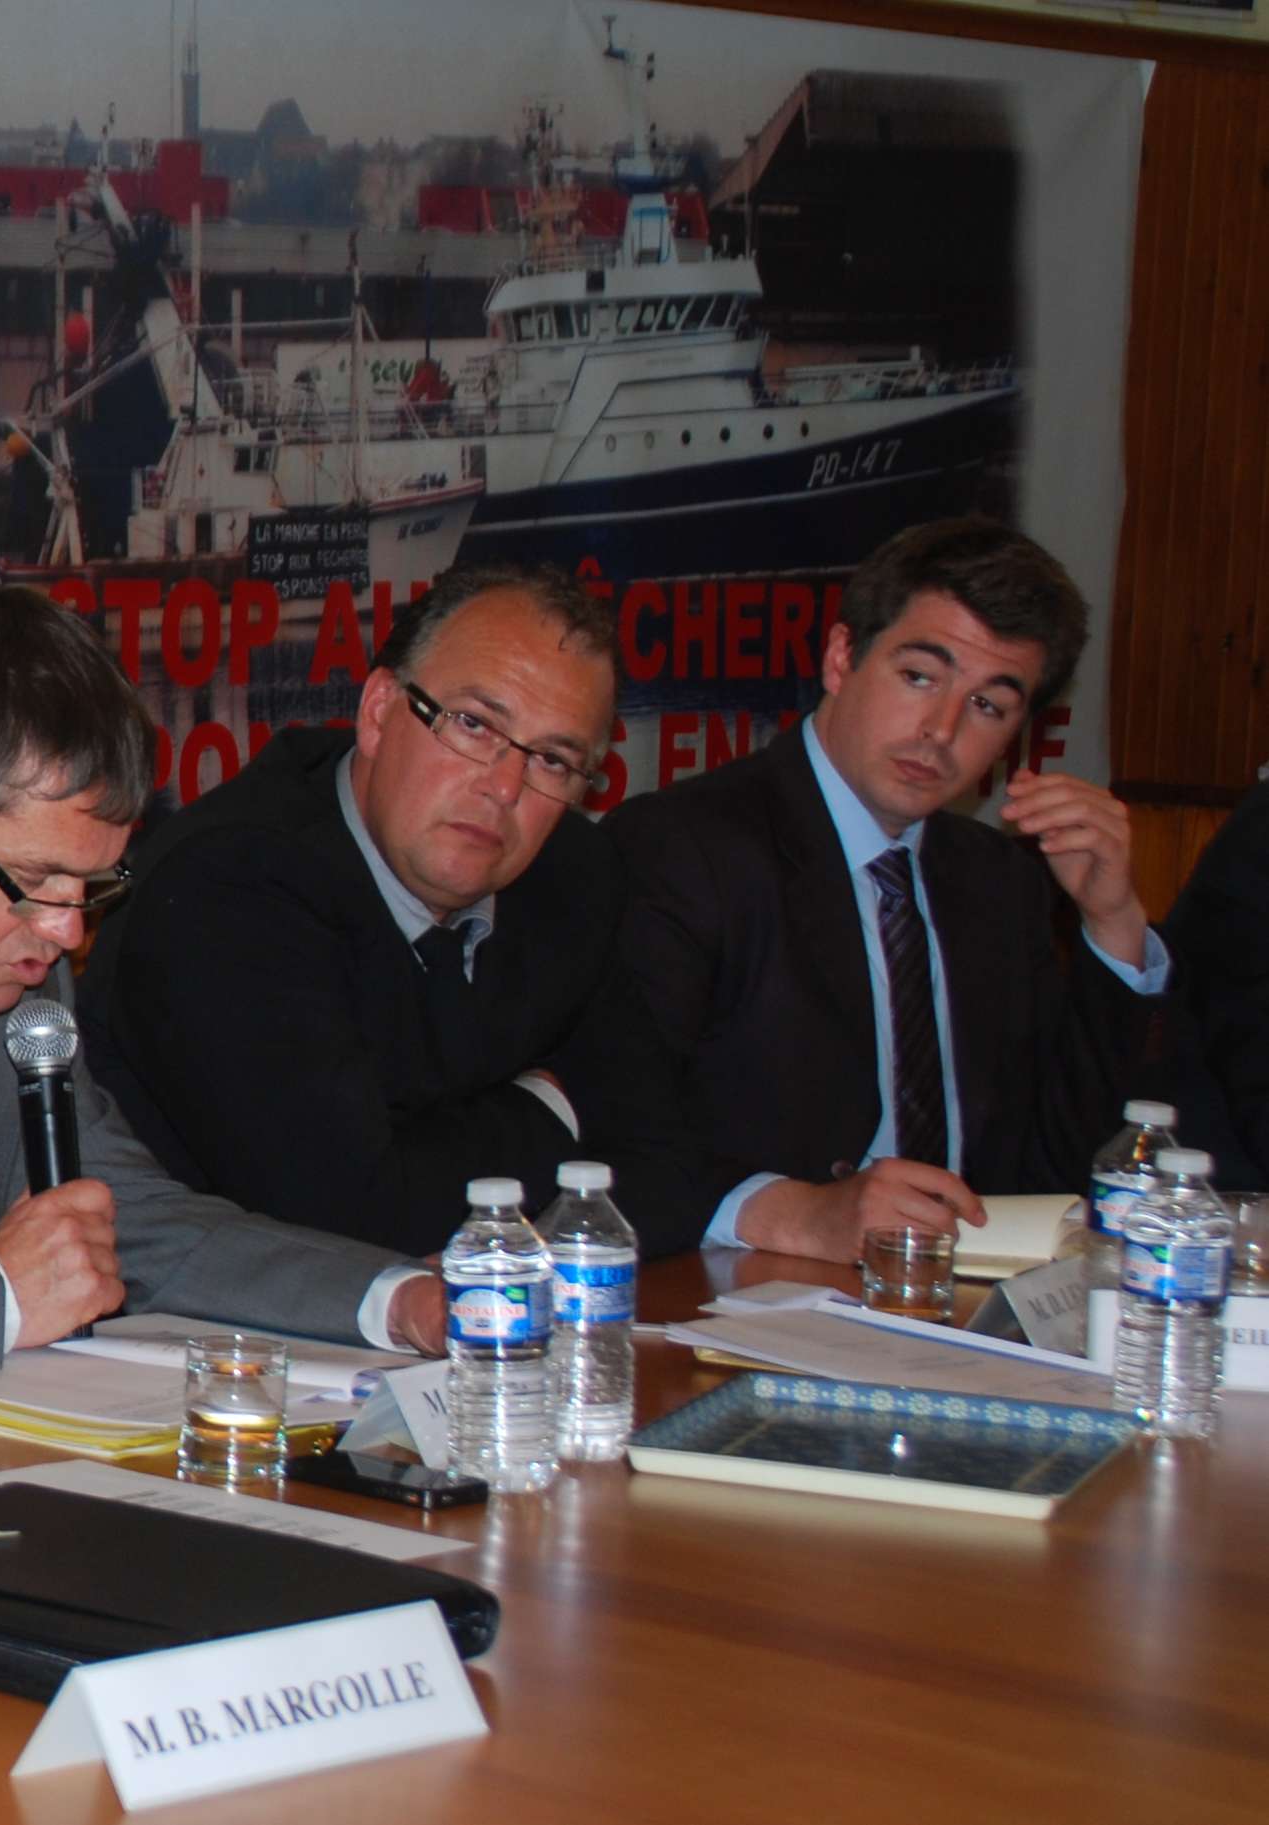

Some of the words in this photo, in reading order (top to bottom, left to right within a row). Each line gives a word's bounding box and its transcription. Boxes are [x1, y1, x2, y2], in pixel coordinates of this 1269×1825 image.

[251, 552, 285, 574] STOP
[123, 1714, 177, 1758] M.
[177, 1706, 221, 1747] B.
[220, 1660, 435, 1737] MARGOLLE
